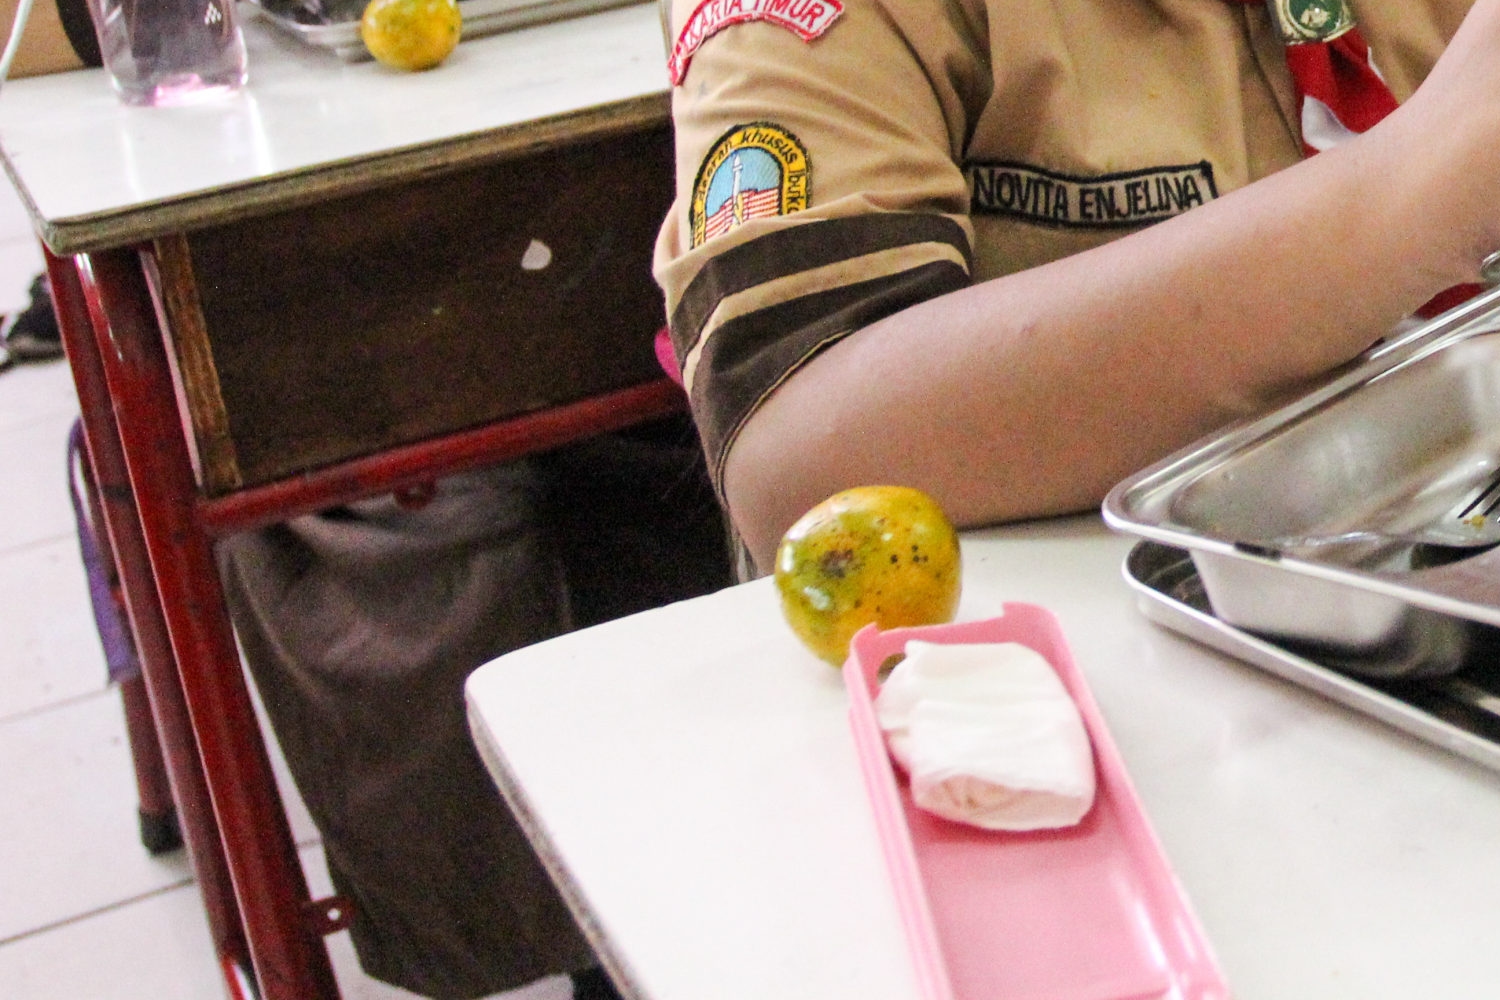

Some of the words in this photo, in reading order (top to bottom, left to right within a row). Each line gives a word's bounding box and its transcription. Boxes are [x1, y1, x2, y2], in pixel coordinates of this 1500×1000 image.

[741, 129, 798, 164] khusus
[973, 167, 1069, 220] NOVITA
[1078, 173, 1203, 220] ENJELINA
